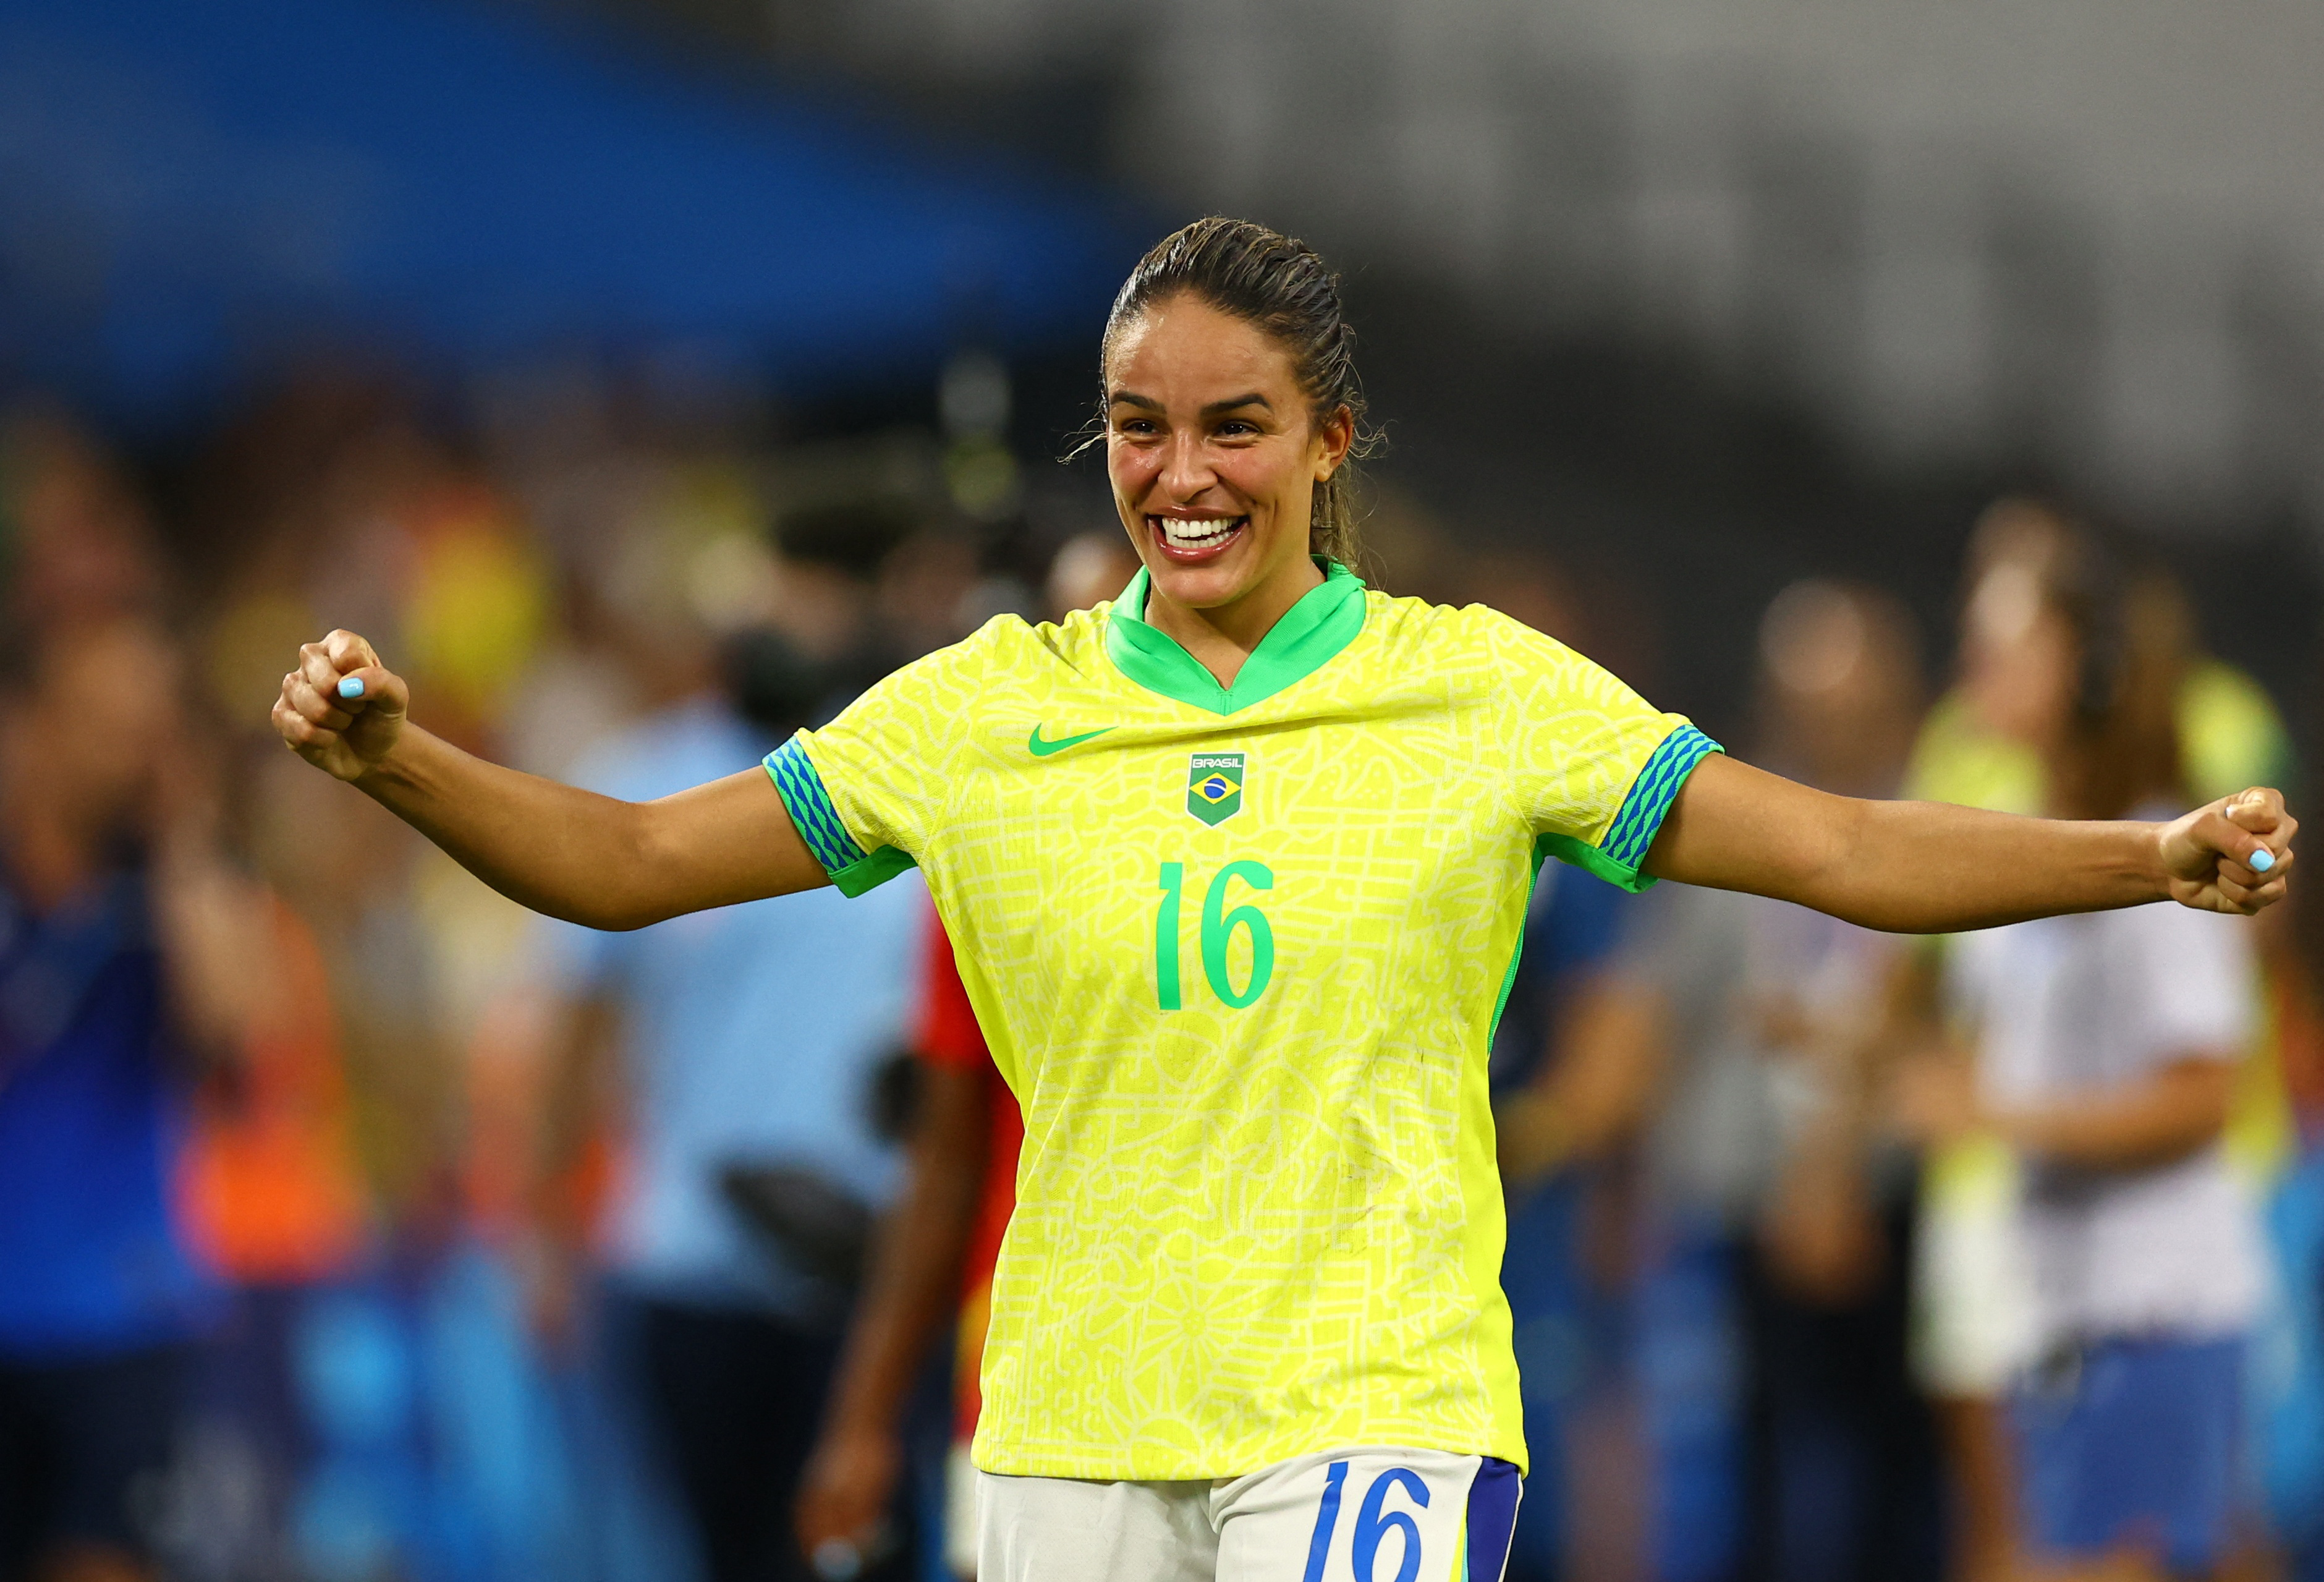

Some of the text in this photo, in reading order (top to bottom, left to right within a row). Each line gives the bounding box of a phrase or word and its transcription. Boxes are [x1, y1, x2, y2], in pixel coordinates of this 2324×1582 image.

[1192, 758, 1242, 768] BRASIL
[1156, 860, 1274, 1010] 16
[1303, 1461, 1430, 1582] 16
